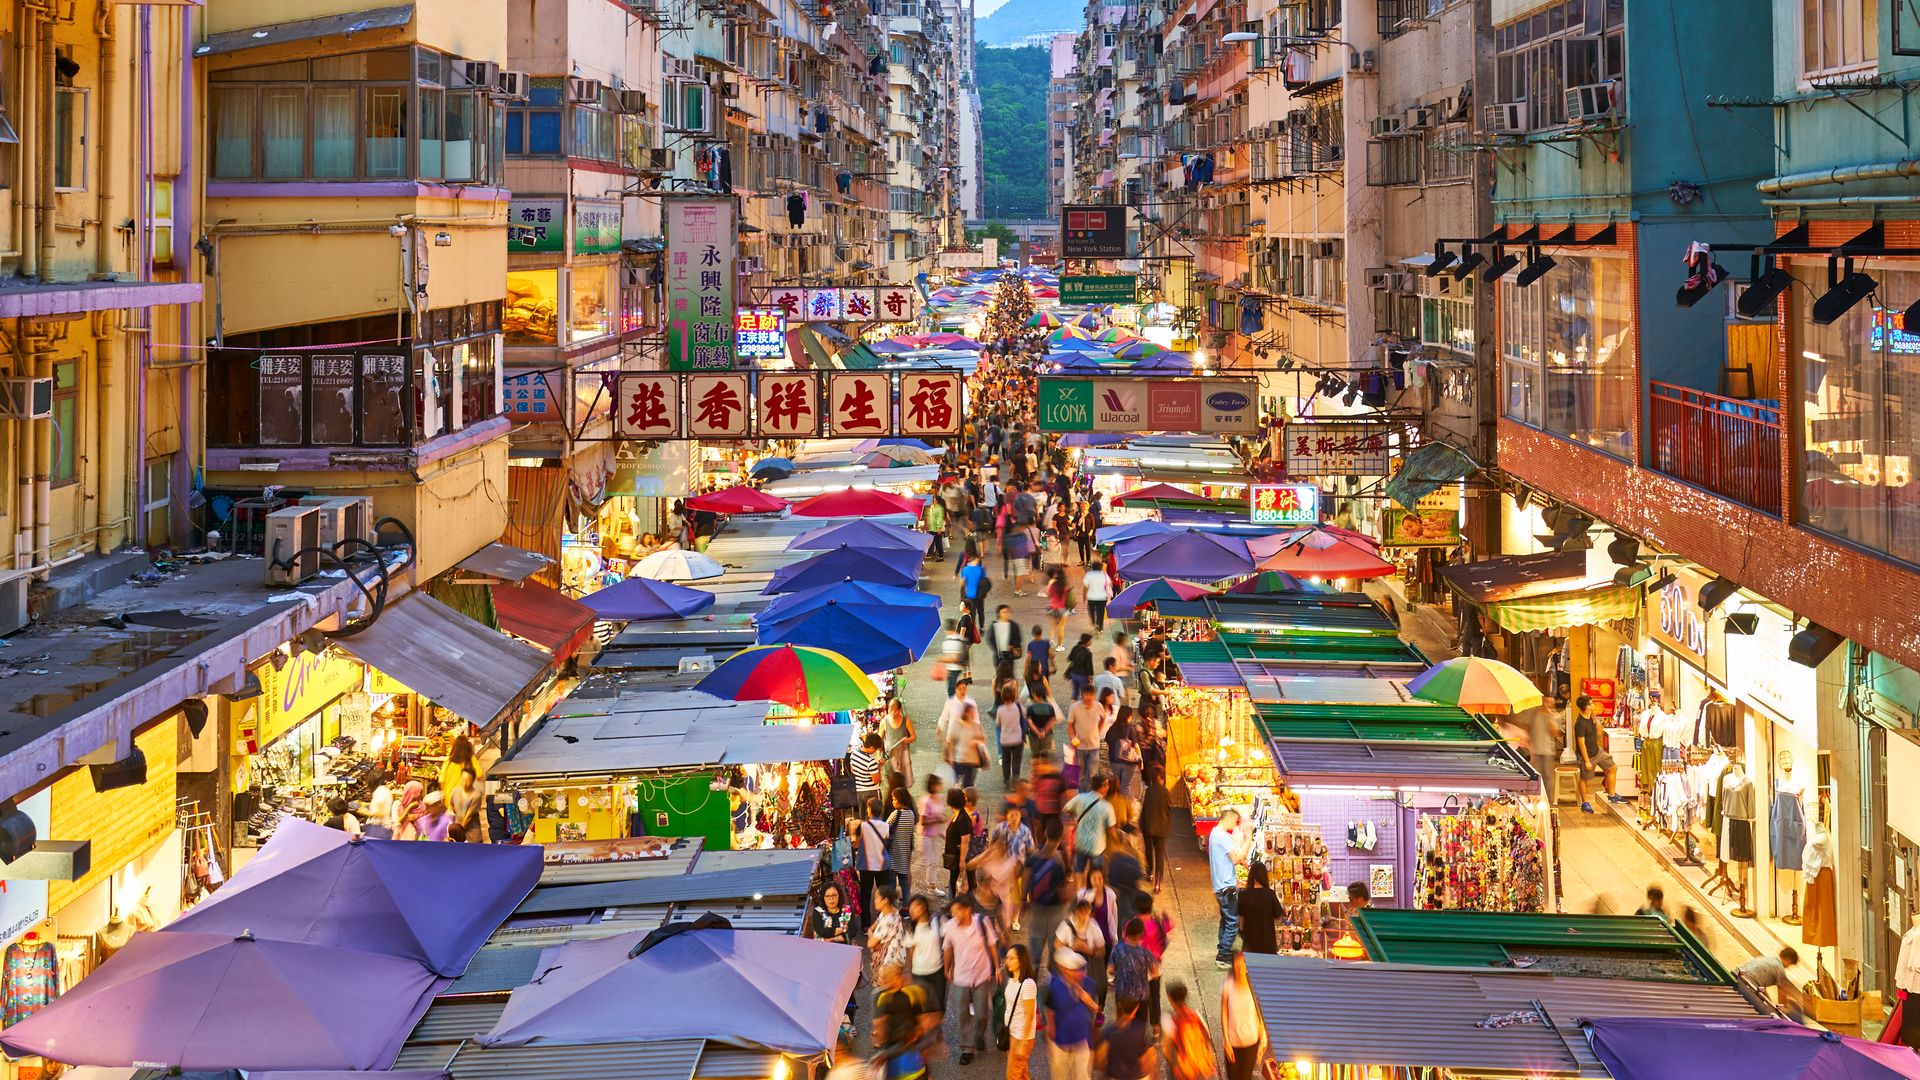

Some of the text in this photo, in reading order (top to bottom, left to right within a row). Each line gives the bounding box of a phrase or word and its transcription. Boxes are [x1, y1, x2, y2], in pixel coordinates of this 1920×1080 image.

[1099, 245, 1121, 253] Station
[700, 244, 722, 318] 永興隆
[1047, 403, 1087, 423] LEONA
[1157, 403, 1192, 415] Triumph
[1100, 412, 1140, 423] Wacoal
